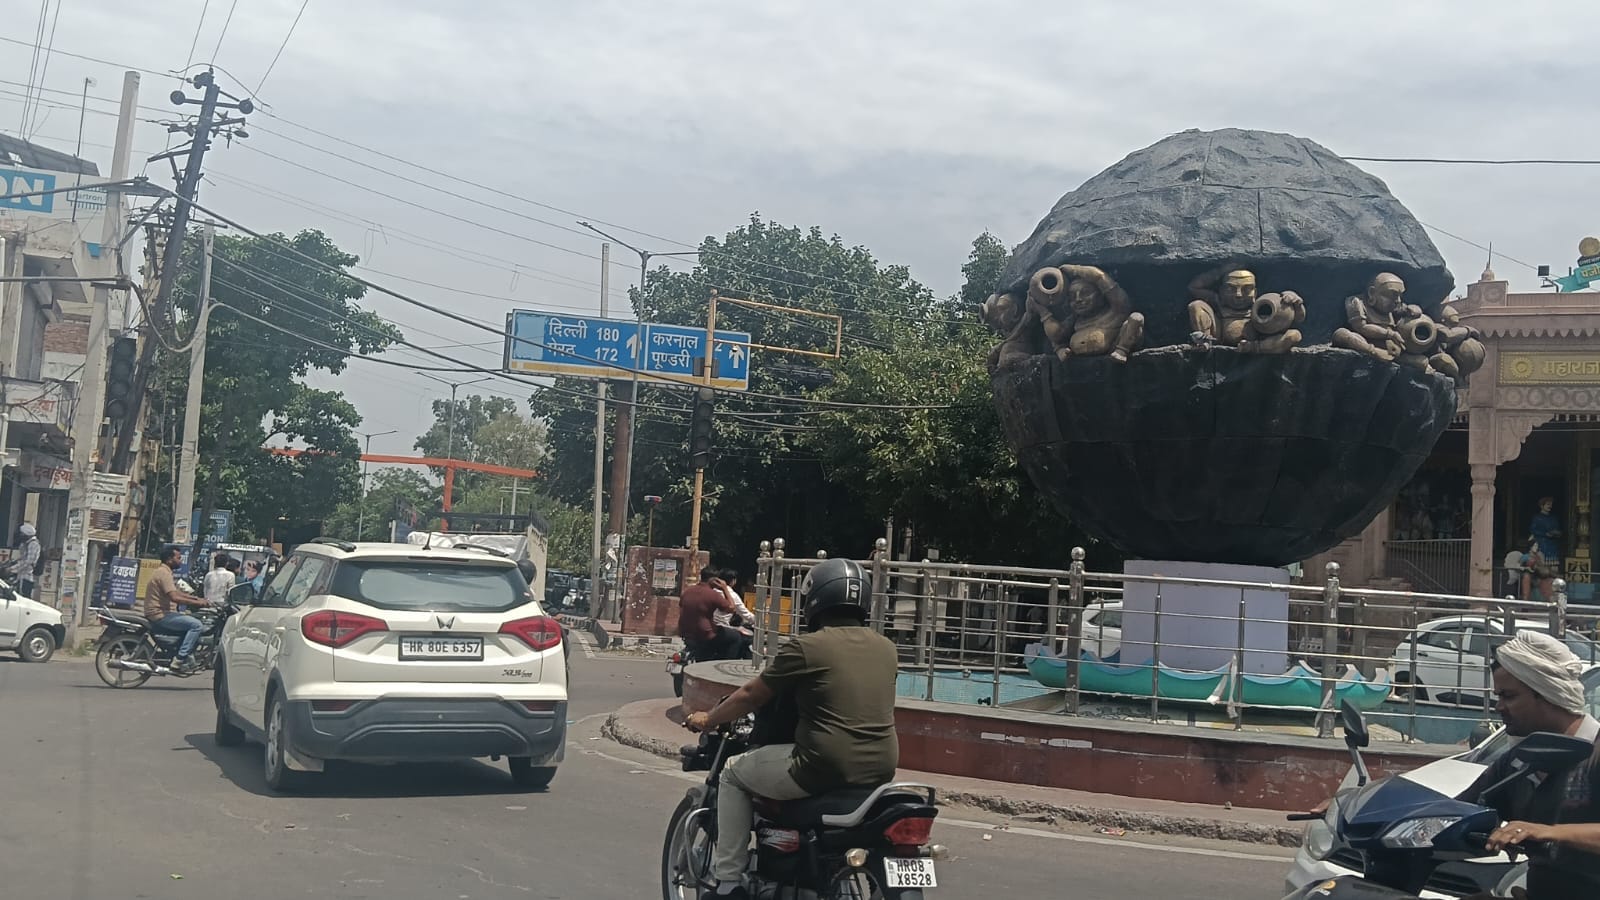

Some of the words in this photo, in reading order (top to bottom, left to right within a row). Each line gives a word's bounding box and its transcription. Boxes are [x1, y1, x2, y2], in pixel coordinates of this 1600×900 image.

[0, 173, 45, 207] N
[548, 317, 588, 339] दिल्ली
[597, 327, 619, 342] 180
[652, 331, 698, 349] करनाल
[595, 347, 618, 362] 172
[651, 349, 690, 370] पूण्डरी
[409, 642, 424, 652] HR
[428, 642, 448, 653] 80E
[452, 642, 480, 653] 6357
[896, 860, 925, 872] HR08
[897, 873, 932, 886] X8528
